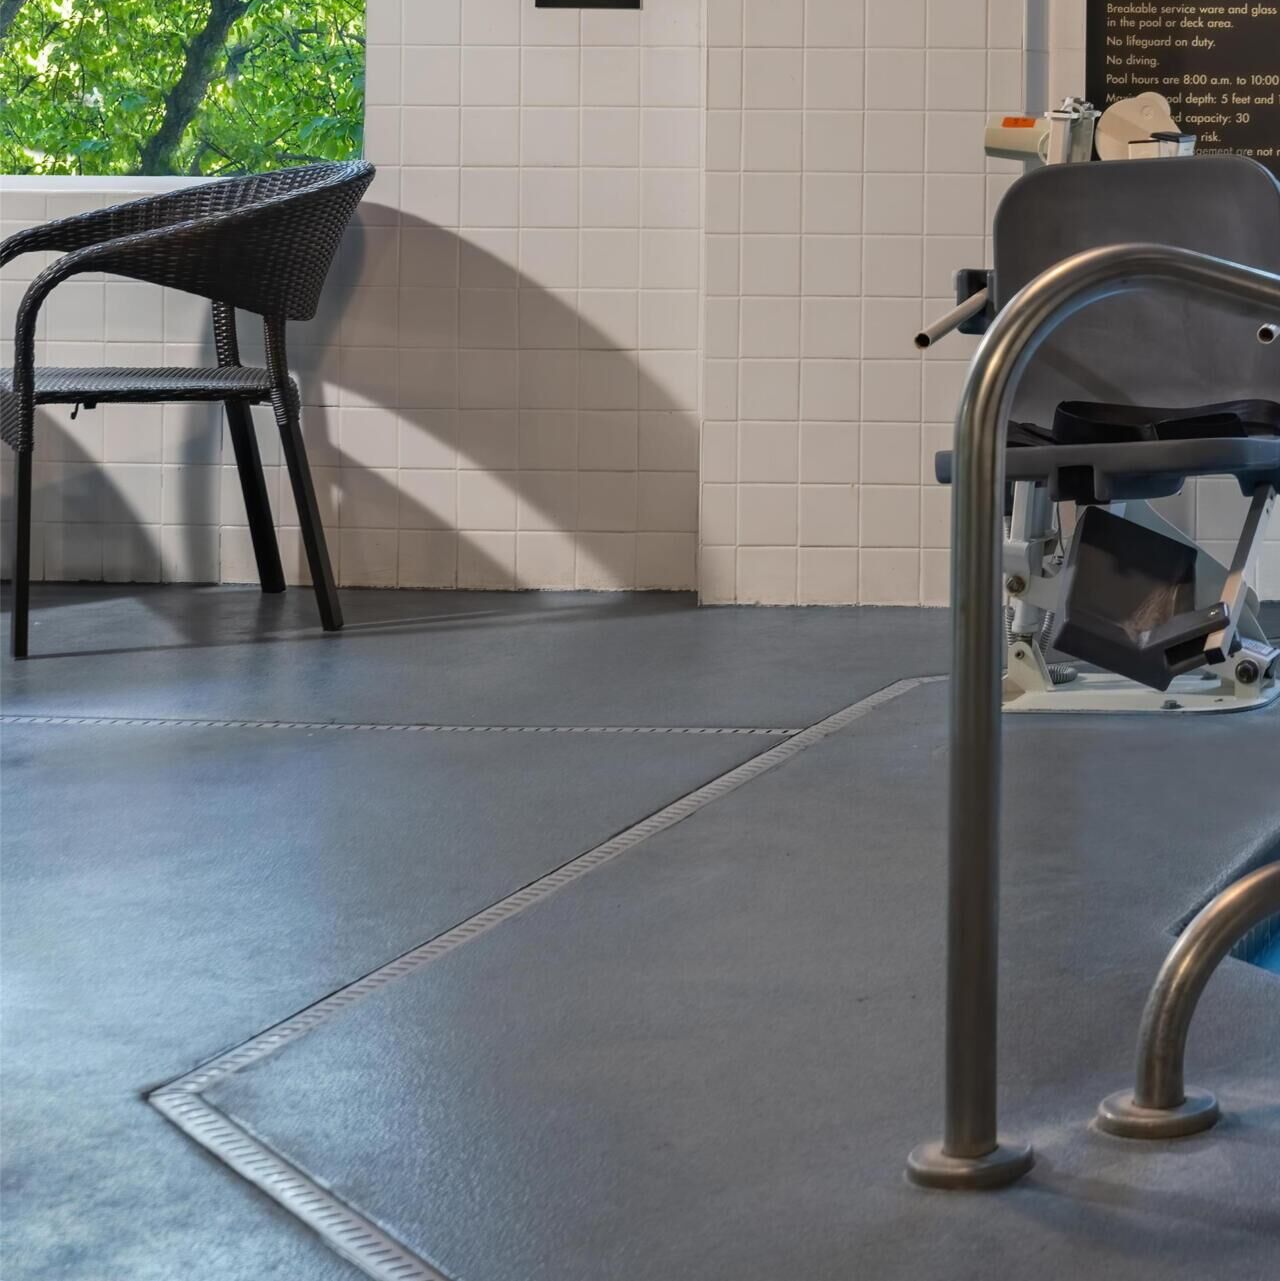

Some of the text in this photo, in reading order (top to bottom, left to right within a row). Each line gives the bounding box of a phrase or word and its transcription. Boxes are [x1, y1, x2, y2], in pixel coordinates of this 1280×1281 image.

[1107, 2, 1157, 14] Breakable
[1159, 4, 1196, 15] service
[1198, 7, 1225, 15] ware
[1228, 3, 1248, 14] and
[1251, 3, 1278, 17] glass
[1107, 17, 1116, 27] in
[1120, 17, 1136, 27] the
[1138, 18, 1162, 30] pool
[1180, 18, 1204, 28] deck
[1106, 36, 1123, 46] No
[1126, 35, 1172, 49] lifeguard
[1191, 36, 1216, 49] duty.
[1106, 54, 1160, 68] No diving.
[1106, 73, 1128, 84] Pool
[1131, 73, 1159, 84] hours
[1183, 74, 1208, 85] 8:00
[1236, 77, 1247, 85] to
[1251, 75, 1280, 85] 10:00
[1185, 93, 1216, 106] depth:
[1221, 94, 1228, 104] 5
[1232, 93, 1251, 104] feet
[1254, 93, 1274, 104] and
[1185, 113, 1232, 126] capacity:
[1236, 113, 1250, 123] 30
[1200, 131, 1221, 142] risk.
[1256, 148, 1273, 156] not
